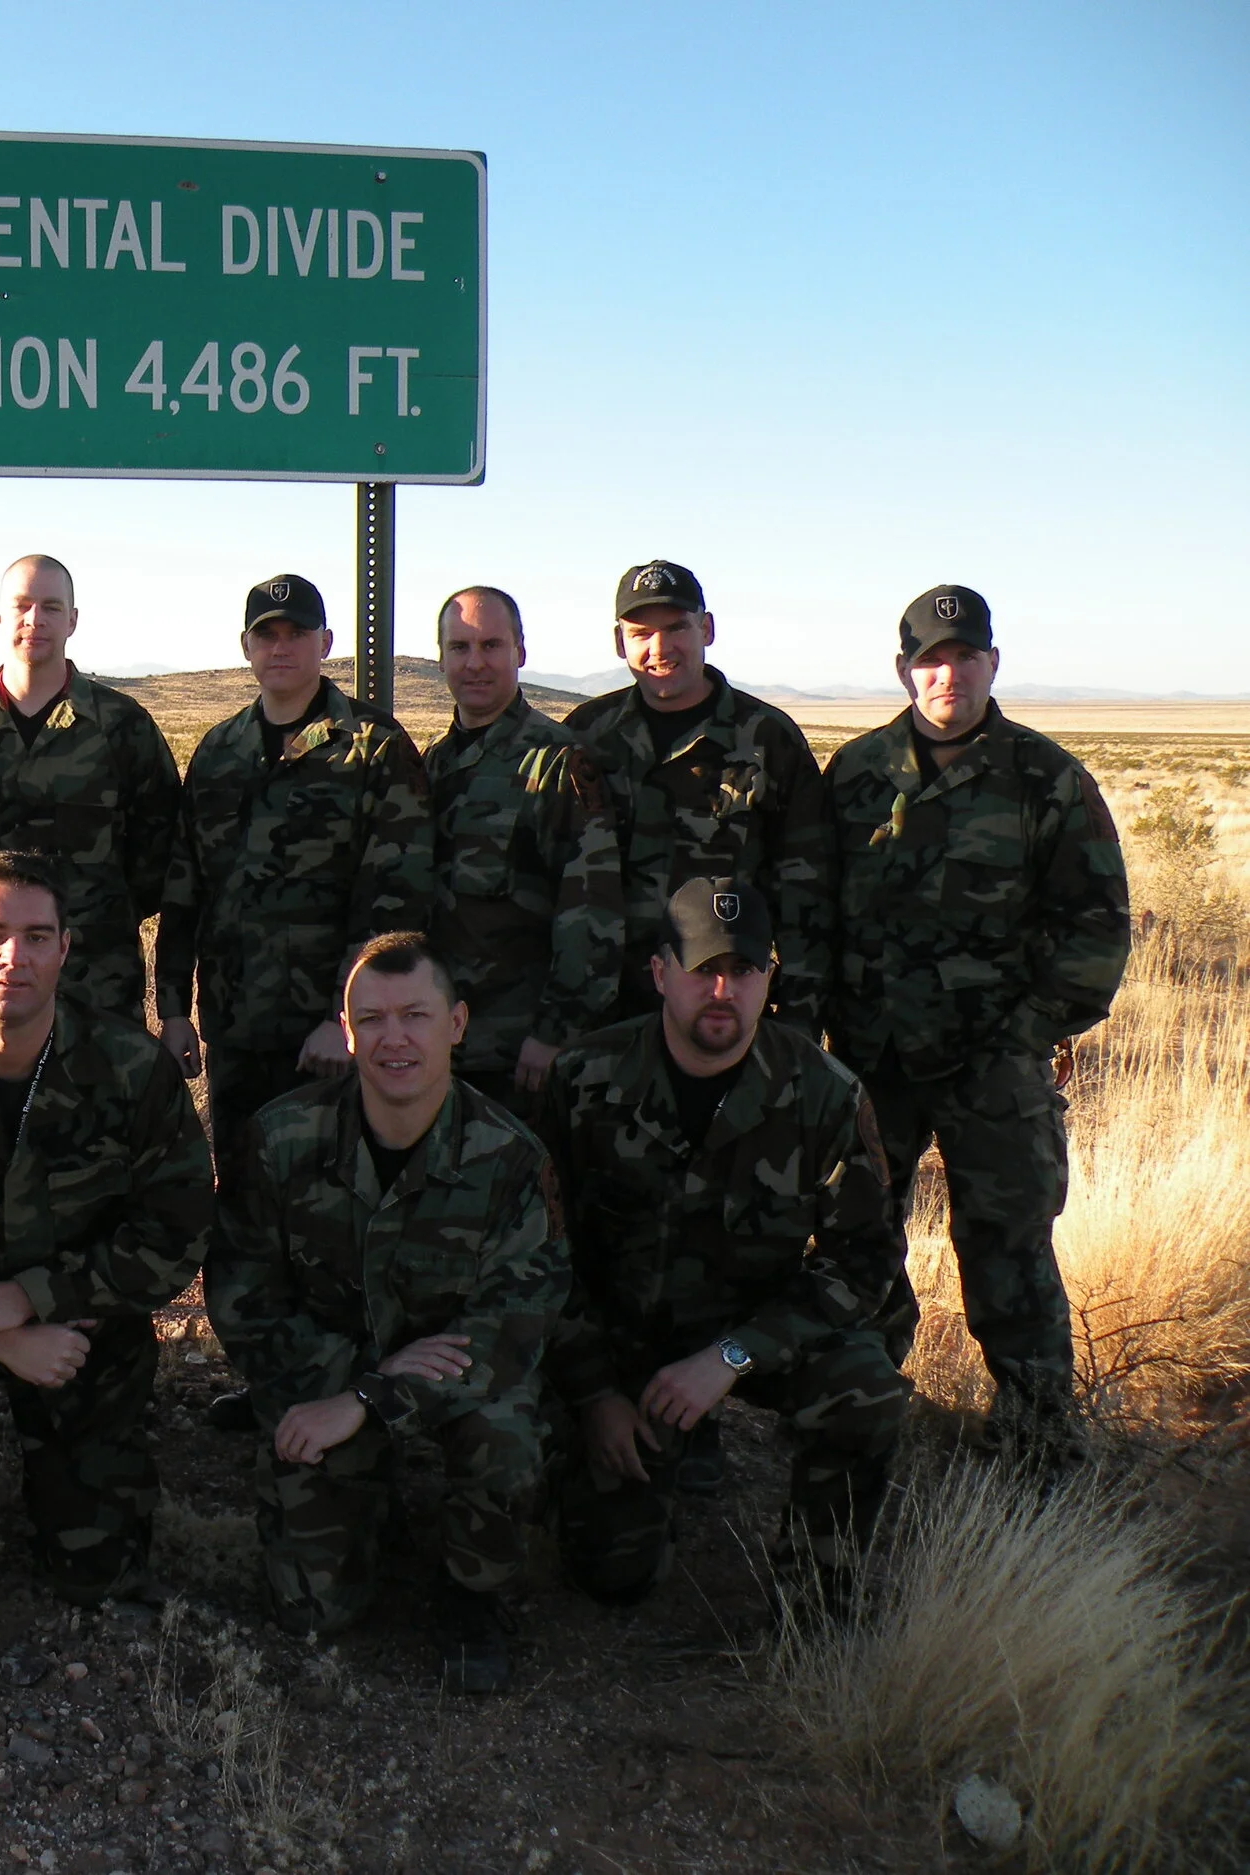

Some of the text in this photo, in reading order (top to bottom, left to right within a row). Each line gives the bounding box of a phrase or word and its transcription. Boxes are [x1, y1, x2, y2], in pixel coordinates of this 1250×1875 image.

[222, 205, 425, 281] DIVIDE
[124, 340, 310, 416] 4,486
[348, 346, 421, 417] FT.
